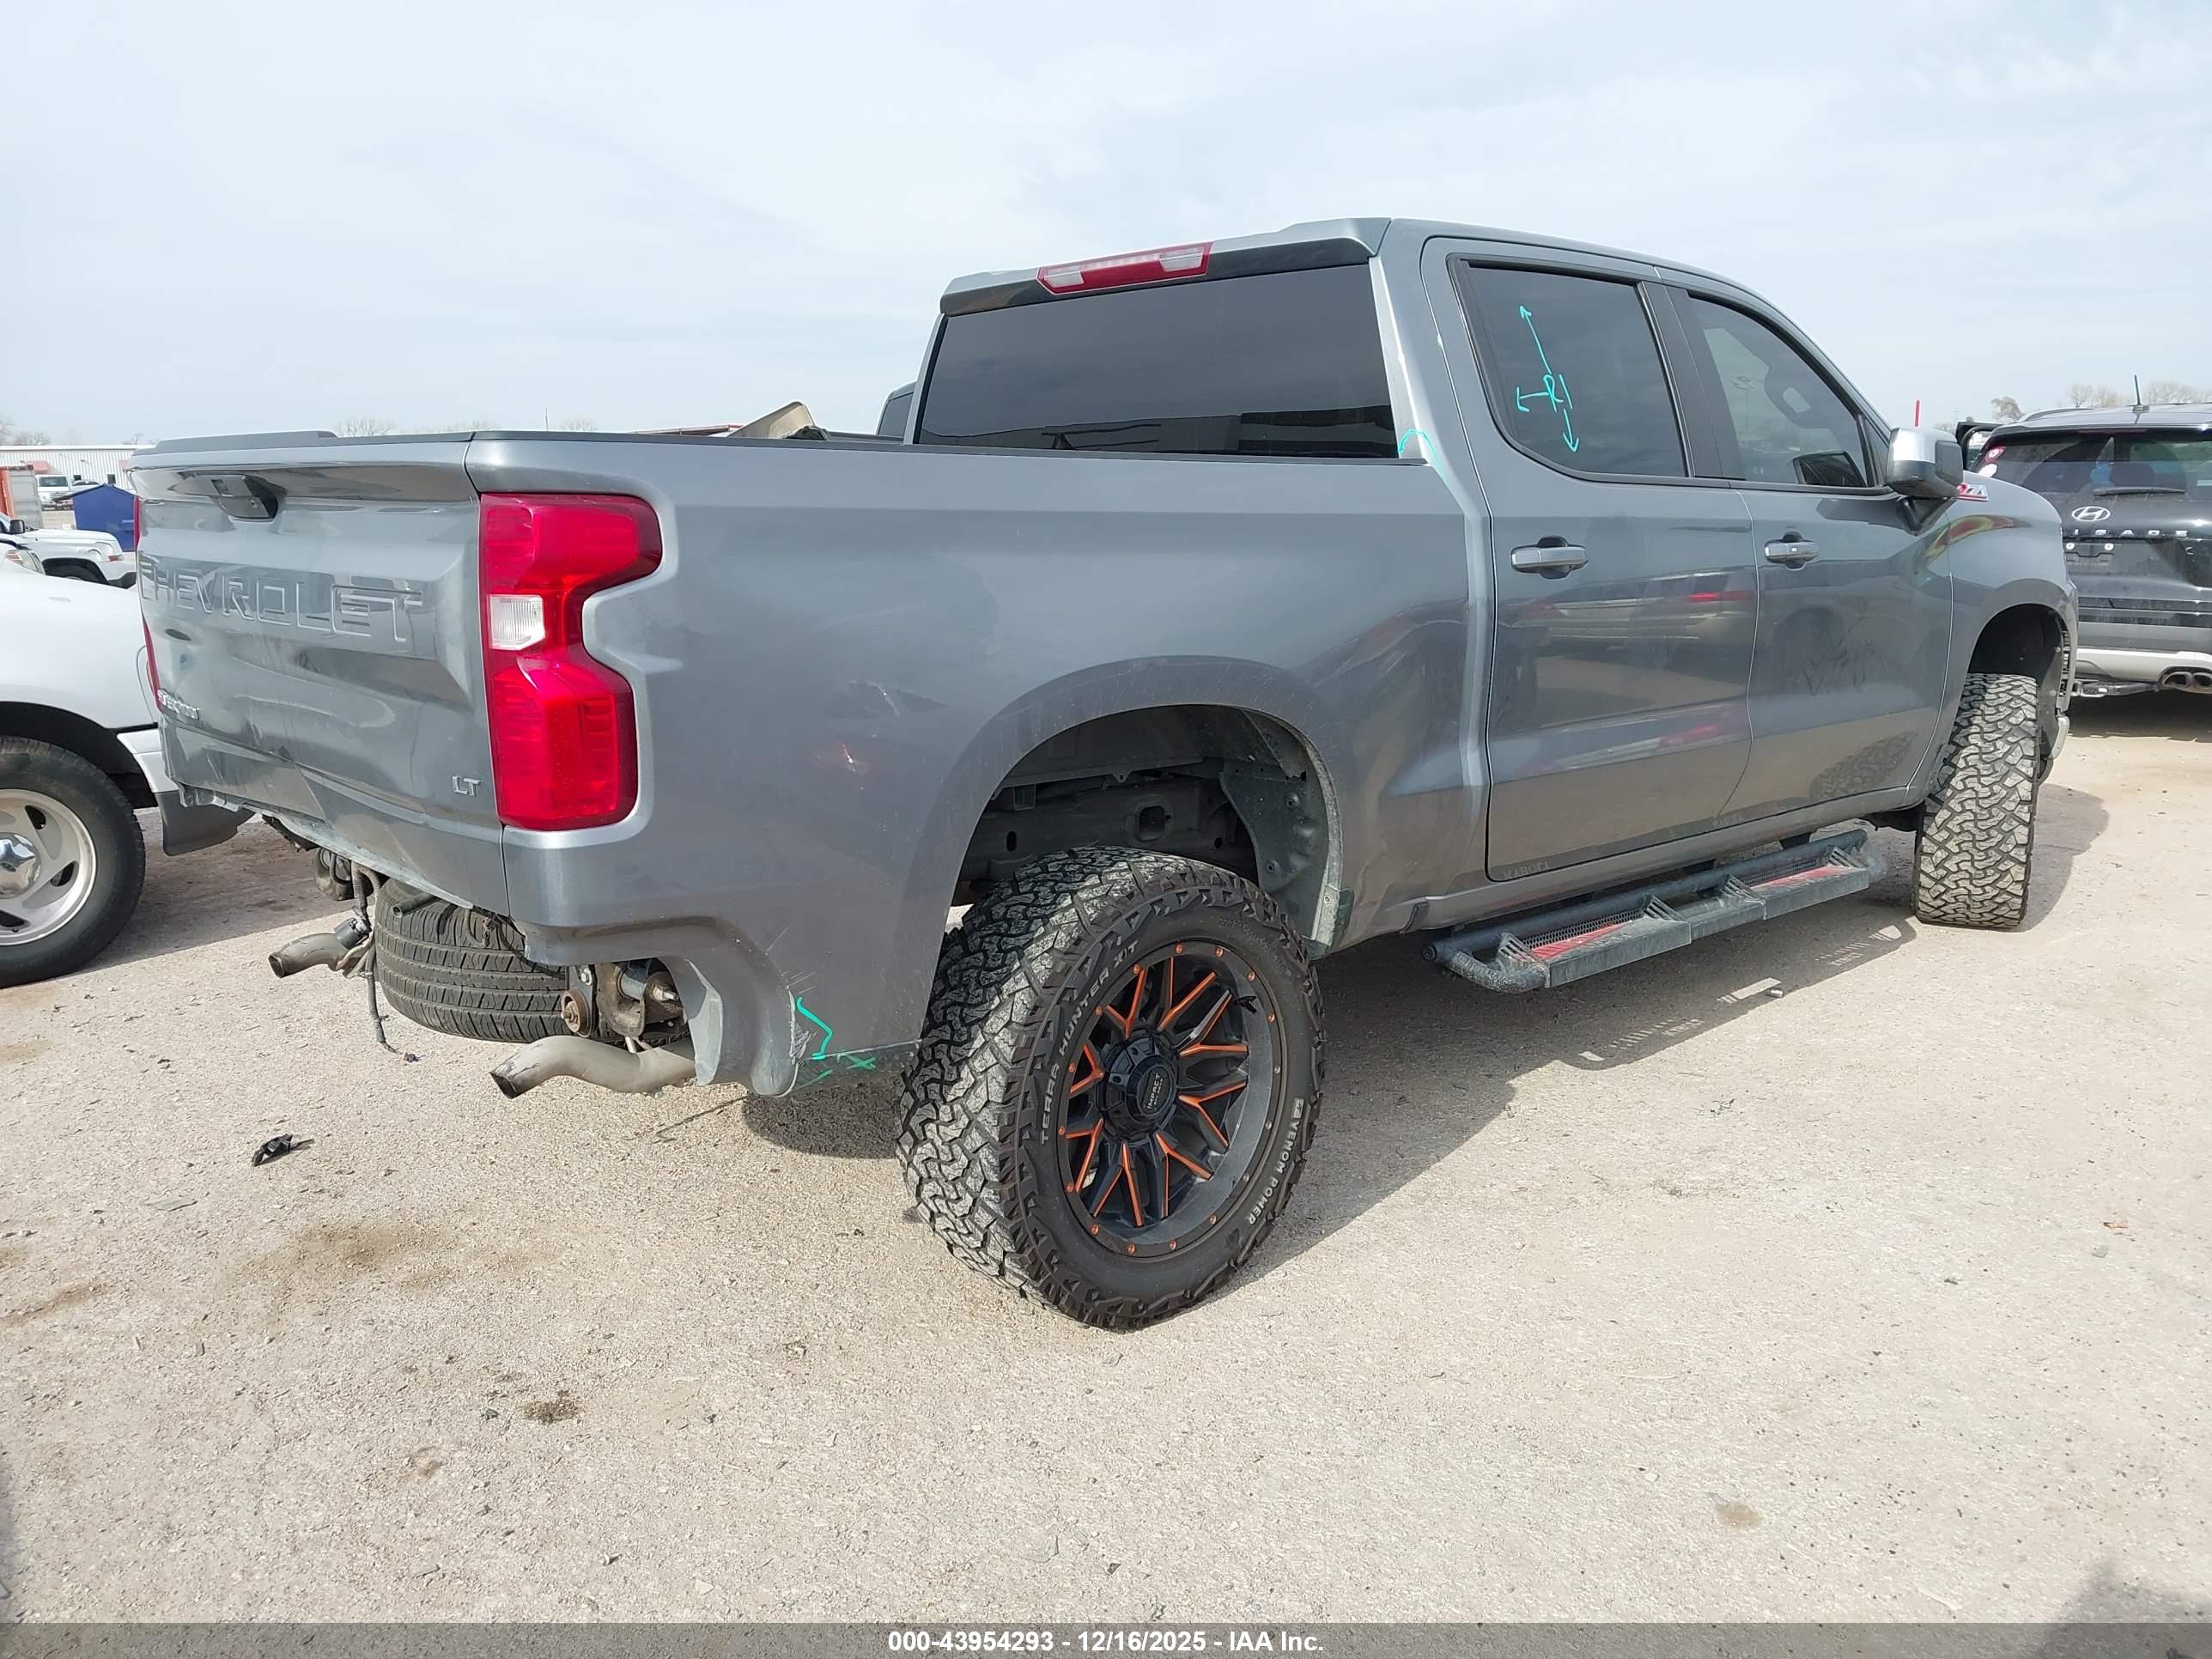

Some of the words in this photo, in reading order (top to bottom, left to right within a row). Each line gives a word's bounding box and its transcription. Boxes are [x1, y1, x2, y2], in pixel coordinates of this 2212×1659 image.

[138, 550, 423, 642] CHEVROLET
[453, 775, 481, 797] LT
[1041, 1062, 1060, 1146] TERRA
[1058, 966, 1110, 1057] HUNTER
[1276, 1120, 1301, 1174] VENOM
[1248, 1177, 1279, 1224] POWER
